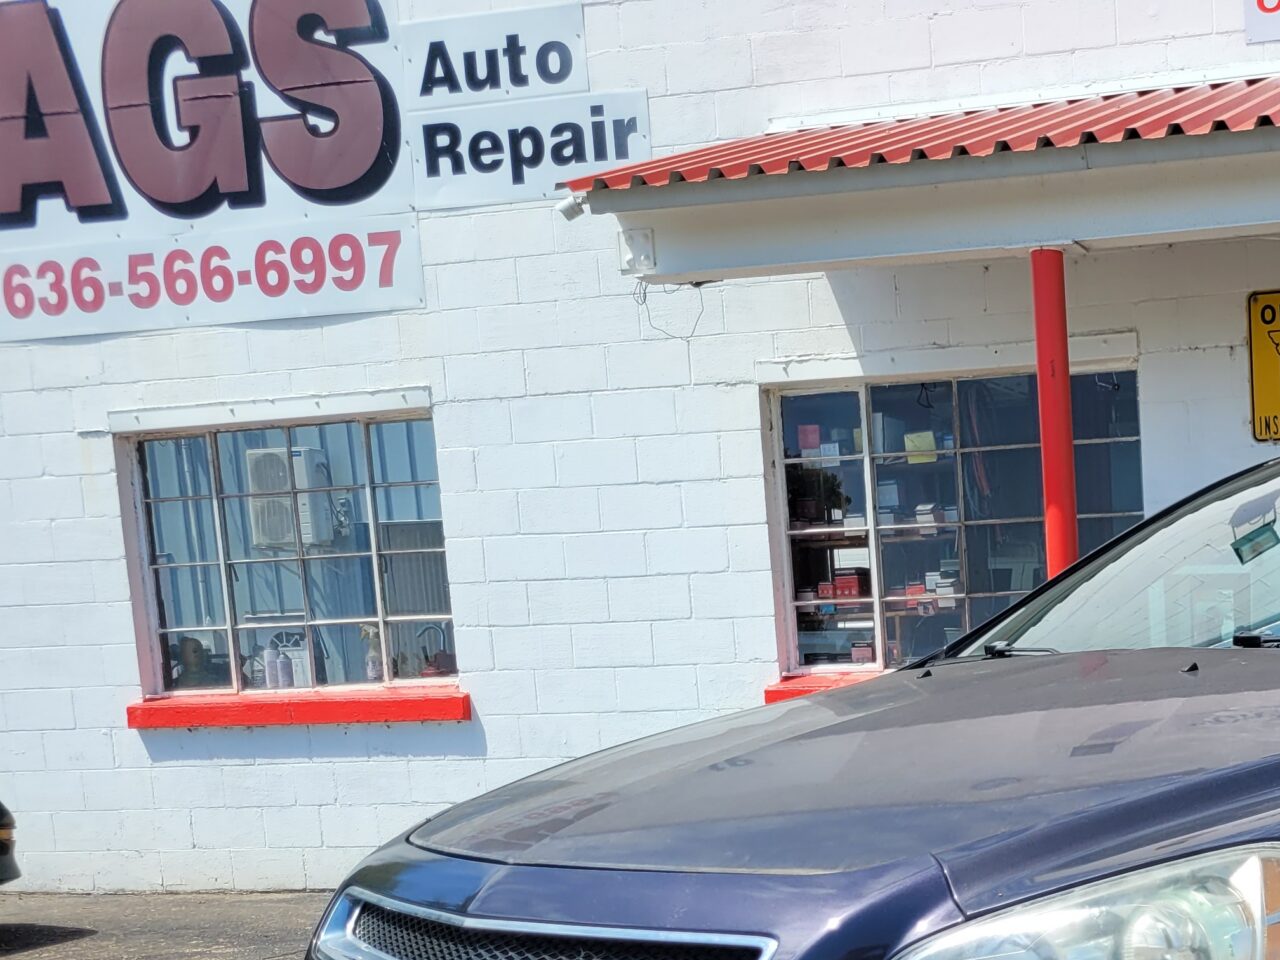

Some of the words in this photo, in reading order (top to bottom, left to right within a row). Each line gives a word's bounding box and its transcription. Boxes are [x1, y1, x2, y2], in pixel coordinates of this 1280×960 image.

[419, 34, 573, 97] Auto
[421, 104, 639, 185] Repair
[3, 229, 402, 319] 636-566-6997
